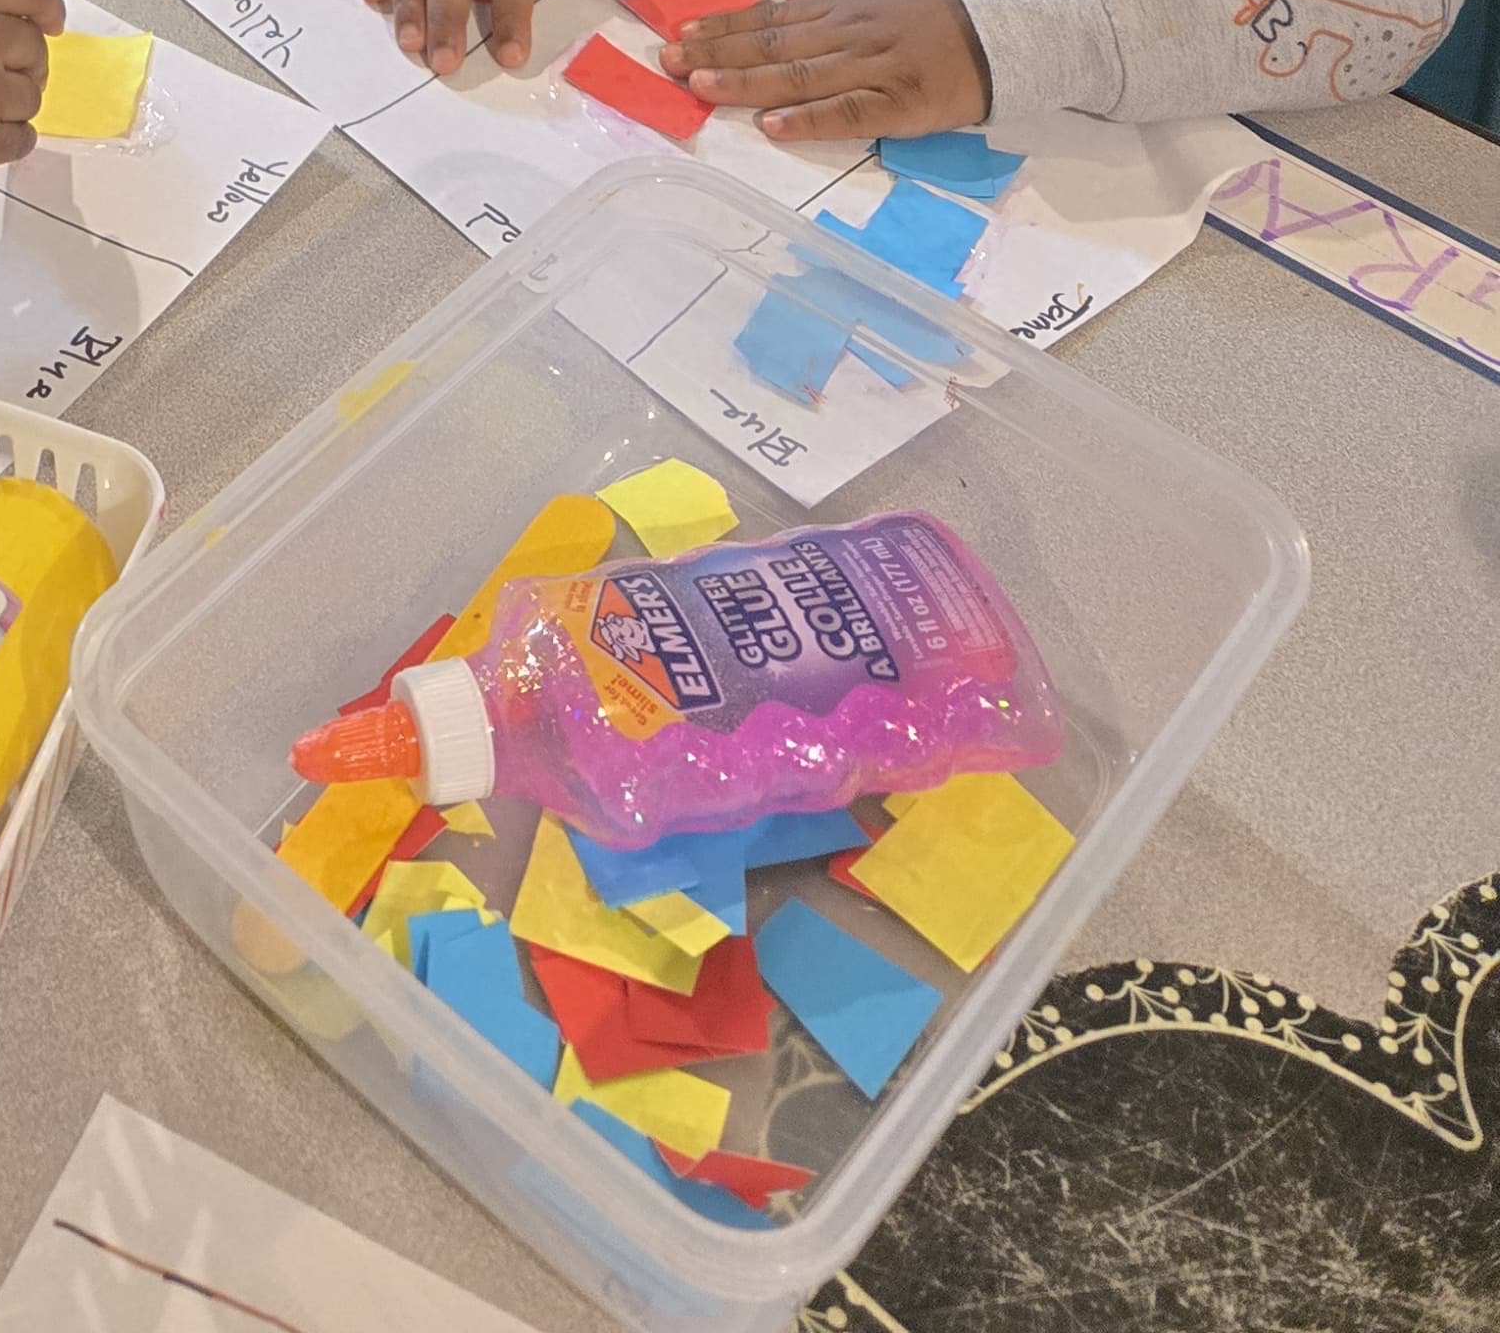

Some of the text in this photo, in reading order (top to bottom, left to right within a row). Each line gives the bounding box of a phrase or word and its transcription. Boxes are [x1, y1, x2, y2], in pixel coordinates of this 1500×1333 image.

[205, 156, 291, 225] Yellow
[26, 323, 125, 400] Blue
[710, 387, 809, 468] Blue
[724, 569, 798, 659] GLUE
[772, 557, 855, 658] COLLE
[796, 541, 896, 677] A BRILLIANTS
[879, 562, 920, 593] (177
[907, 594, 930, 616] oz
[619, 577, 712, 697] ELMER'S
[700, 576, 764, 666] GLITTER
[915, 619, 940, 634] fl
[925, 636, 948, 650] 6
